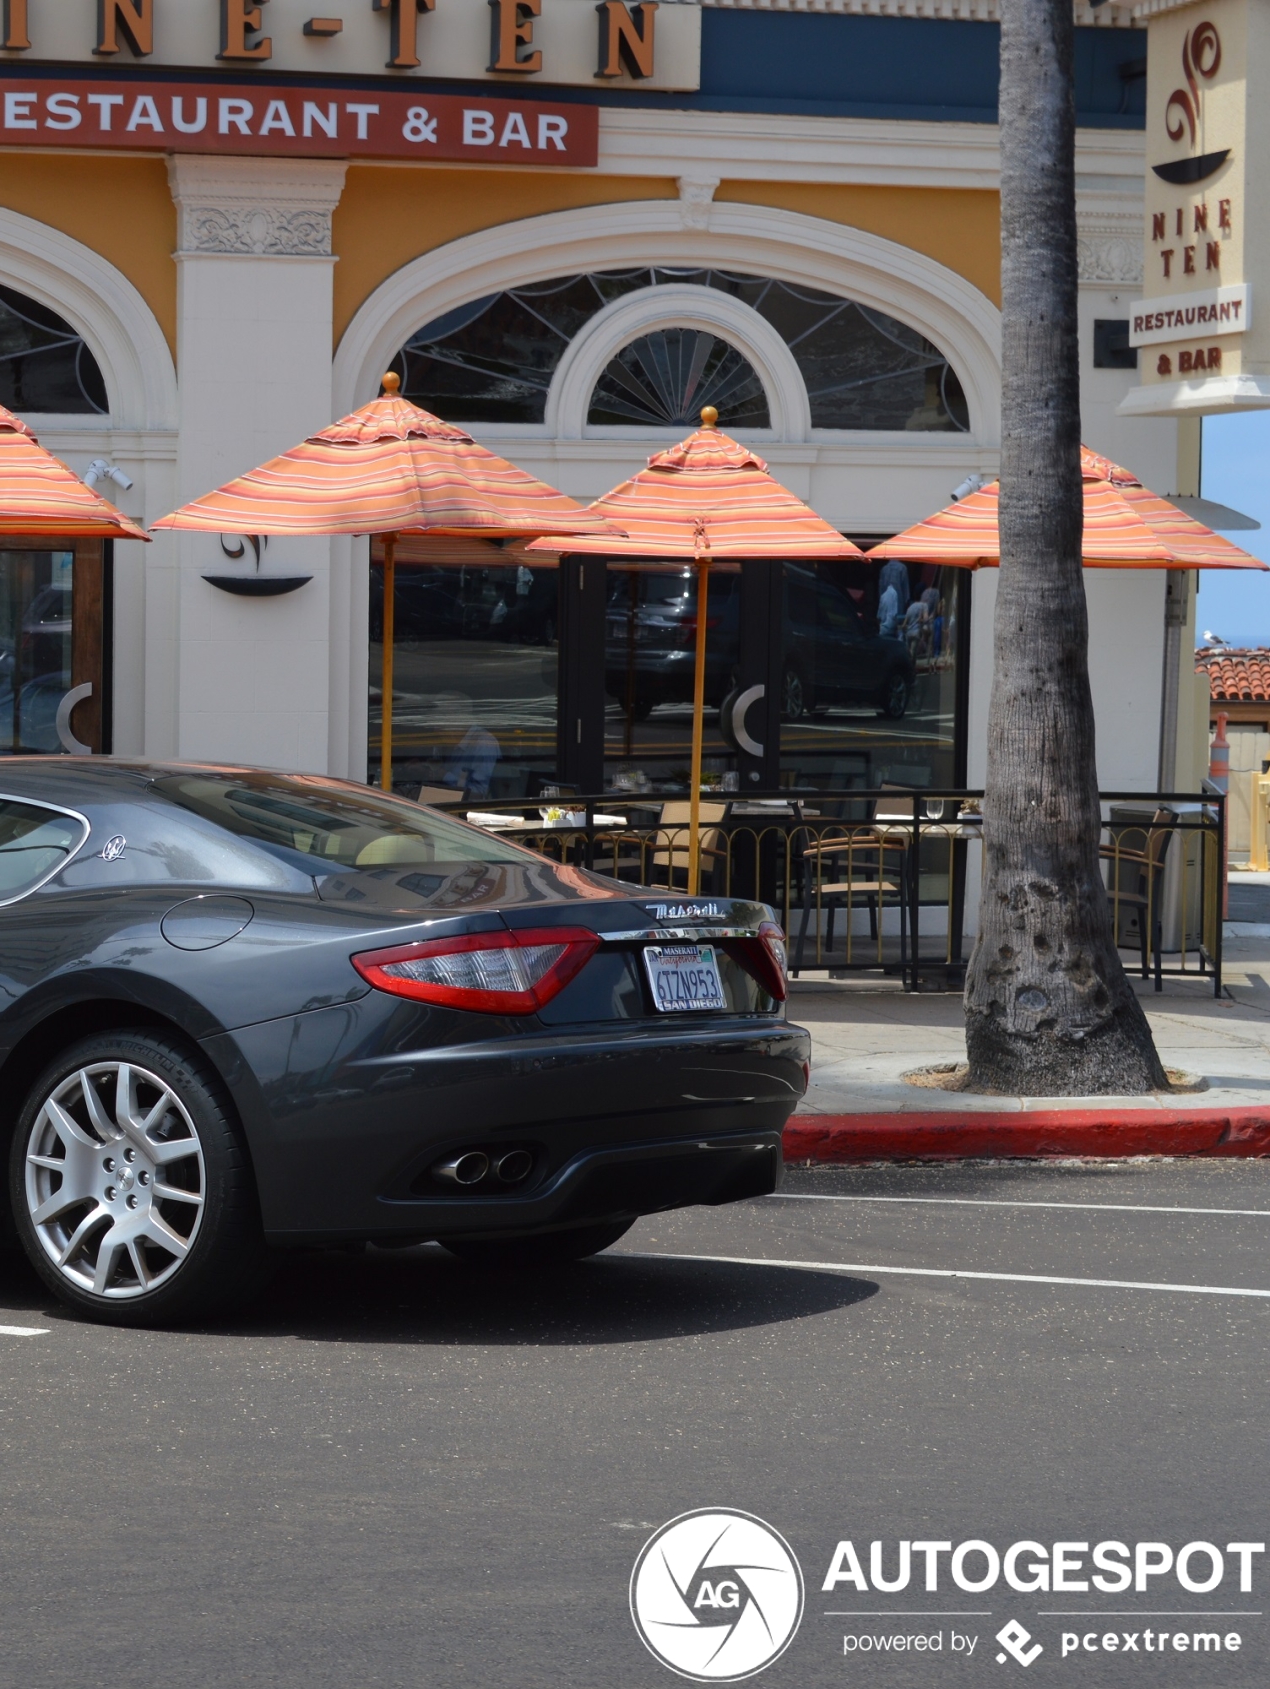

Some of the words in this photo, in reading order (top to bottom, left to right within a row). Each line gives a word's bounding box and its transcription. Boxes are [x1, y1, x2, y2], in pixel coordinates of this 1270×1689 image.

[402, 106, 437, 143] &
[462, 109, 568, 151] BAR
[1152, 199, 1232, 241] NINE
[1160, 241, 1220, 278] TEN
[1133, 300, 1242, 333] RESTAURANT
[1157, 354, 1172, 375] &
[1179, 347, 1222, 373] BAR
[663, 947, 696, 955] MASERATI
[657, 970, 718, 1000] 6TZN953
[664, 1000, 686, 1010] SAN
[690, 998, 722, 1009] DIEGO
[120, 1040, 175, 1073] MICHELIN
